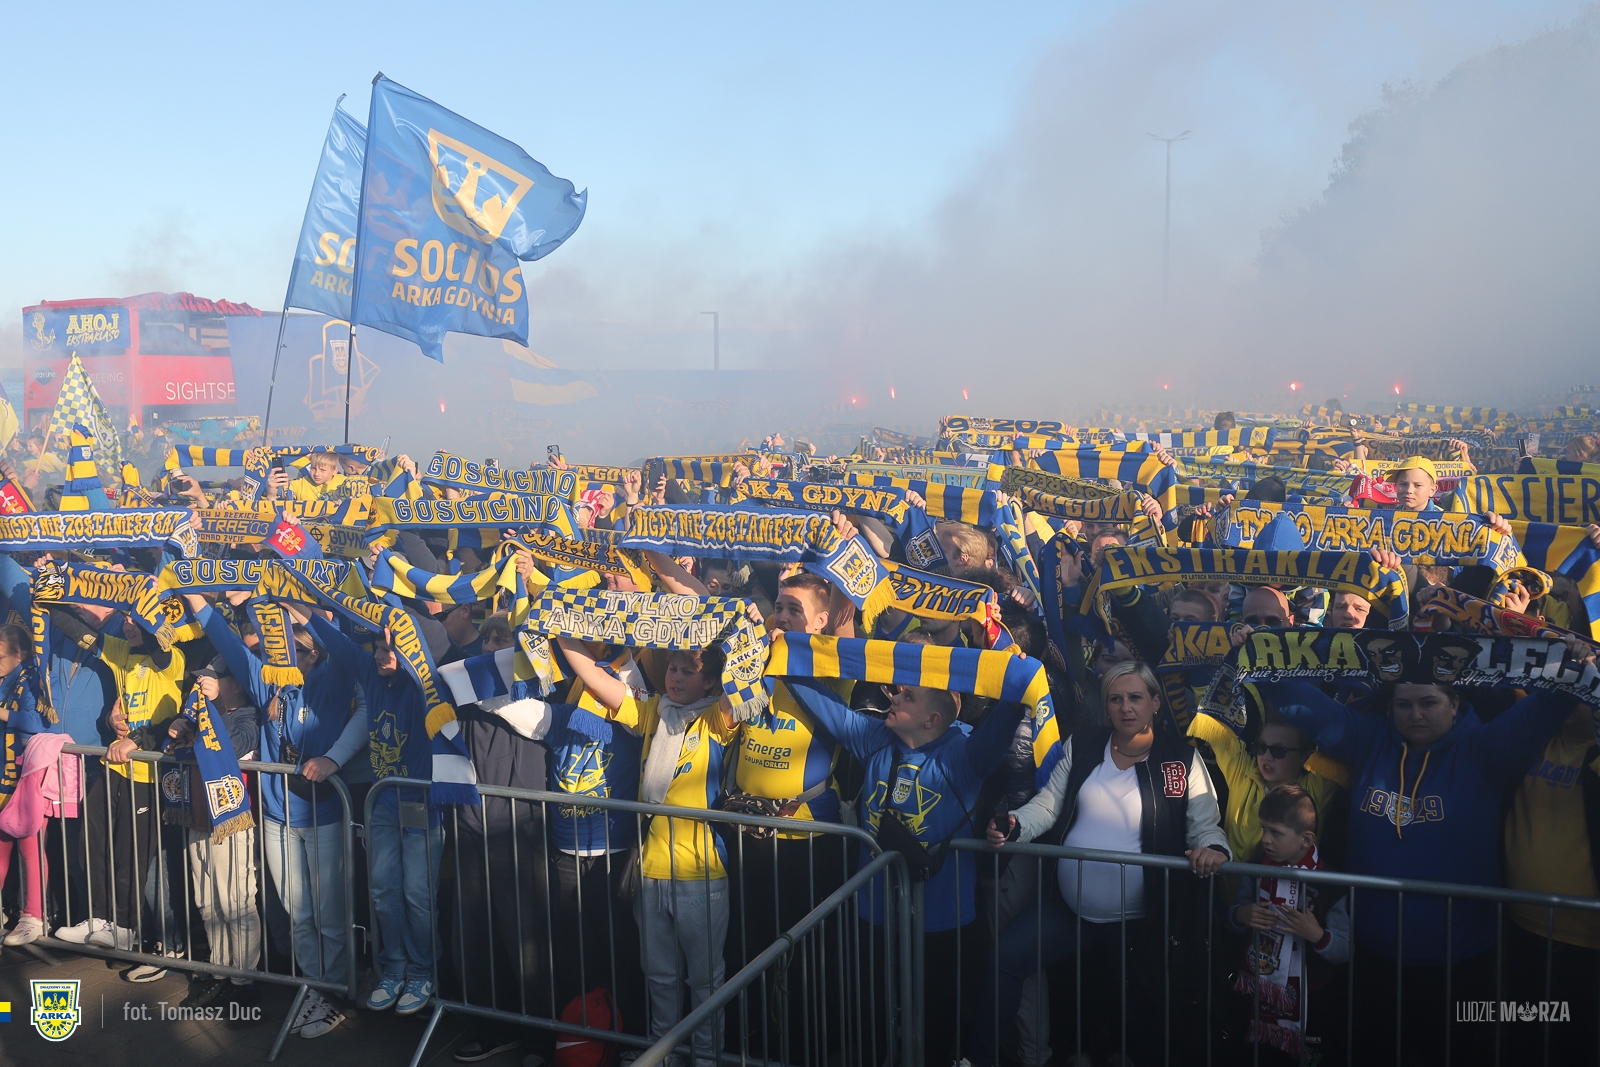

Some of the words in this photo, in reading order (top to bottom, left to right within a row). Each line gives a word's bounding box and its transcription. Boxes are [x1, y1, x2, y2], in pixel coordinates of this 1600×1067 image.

[391, 238, 523, 303] SOCIOS
[391, 281, 442, 307] ARKA
[444, 286, 515, 325] GDYNIA
[66, 313, 119, 334] AHOJ
[802, 484, 911, 525] GDYNIA
[1236, 509, 1312, 544] TYO
[1319, 517, 1385, 550] ARKA
[912, 543, 928, 566] ARKA
[172, 558, 351, 587] GOSCINO
[851, 564, 871, 587] ARKA
[604, 591, 700, 617] TYLKO
[545, 607, 624, 641] ARKA
[388, 607, 441, 706] SPORTOWY
[730, 648, 759, 667] ARKA
[1251, 667, 1272, 678] nie
[744, 755, 763, 766] GRUPA
[764, 760, 789, 769] ORLEN
[746, 738, 792, 760] Energa
[222, 780, 236, 806] ARKA
[1389, 808, 1411, 818] AKA
